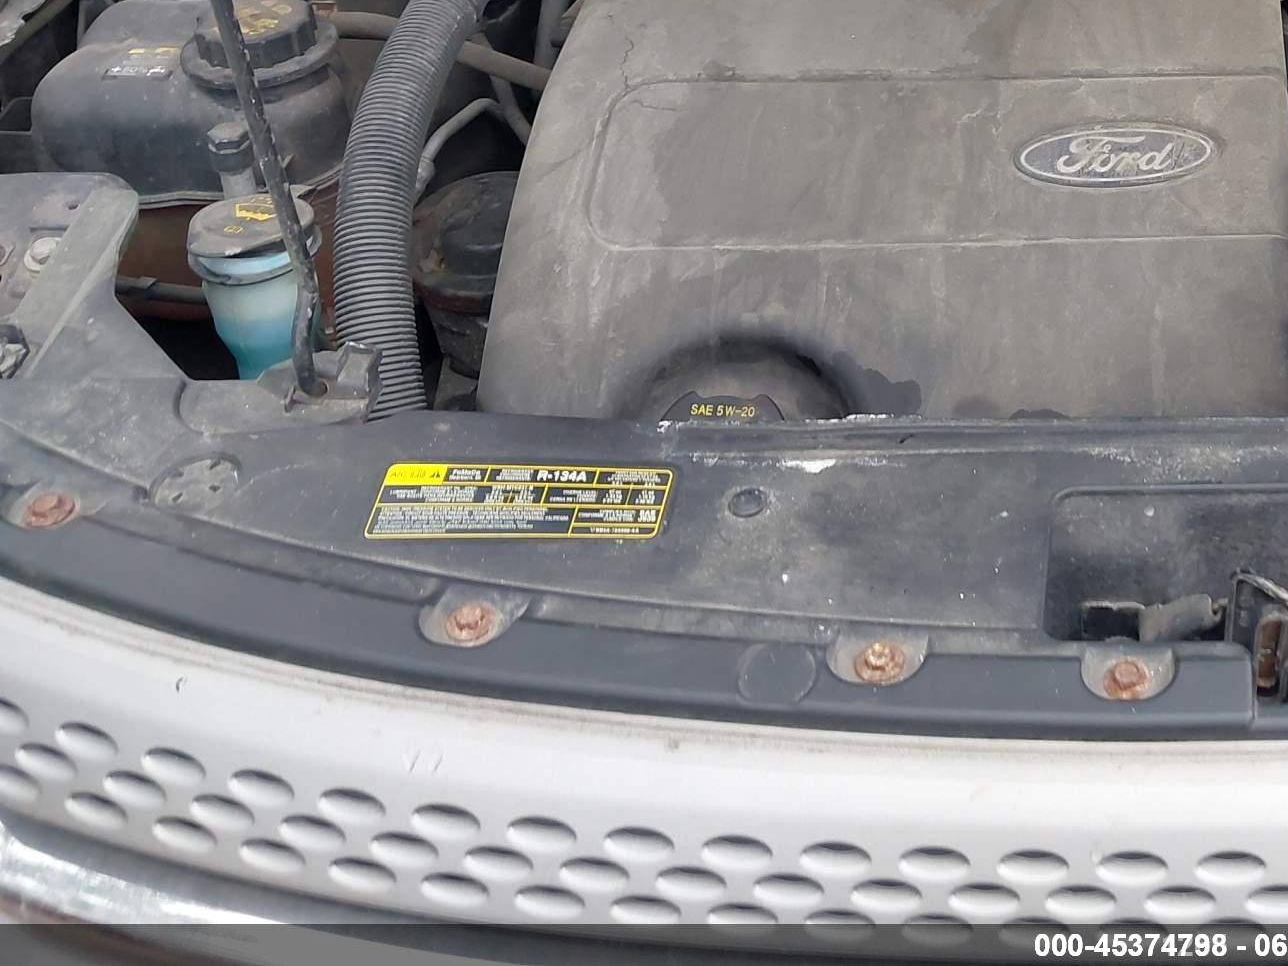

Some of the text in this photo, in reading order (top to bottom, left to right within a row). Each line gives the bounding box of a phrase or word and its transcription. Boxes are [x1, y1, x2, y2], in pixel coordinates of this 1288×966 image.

[1056, 135, 1173, 173] Ford
[690, 403, 755, 418] SAE 5W-20
[536, 470, 587, 483] R-134A
